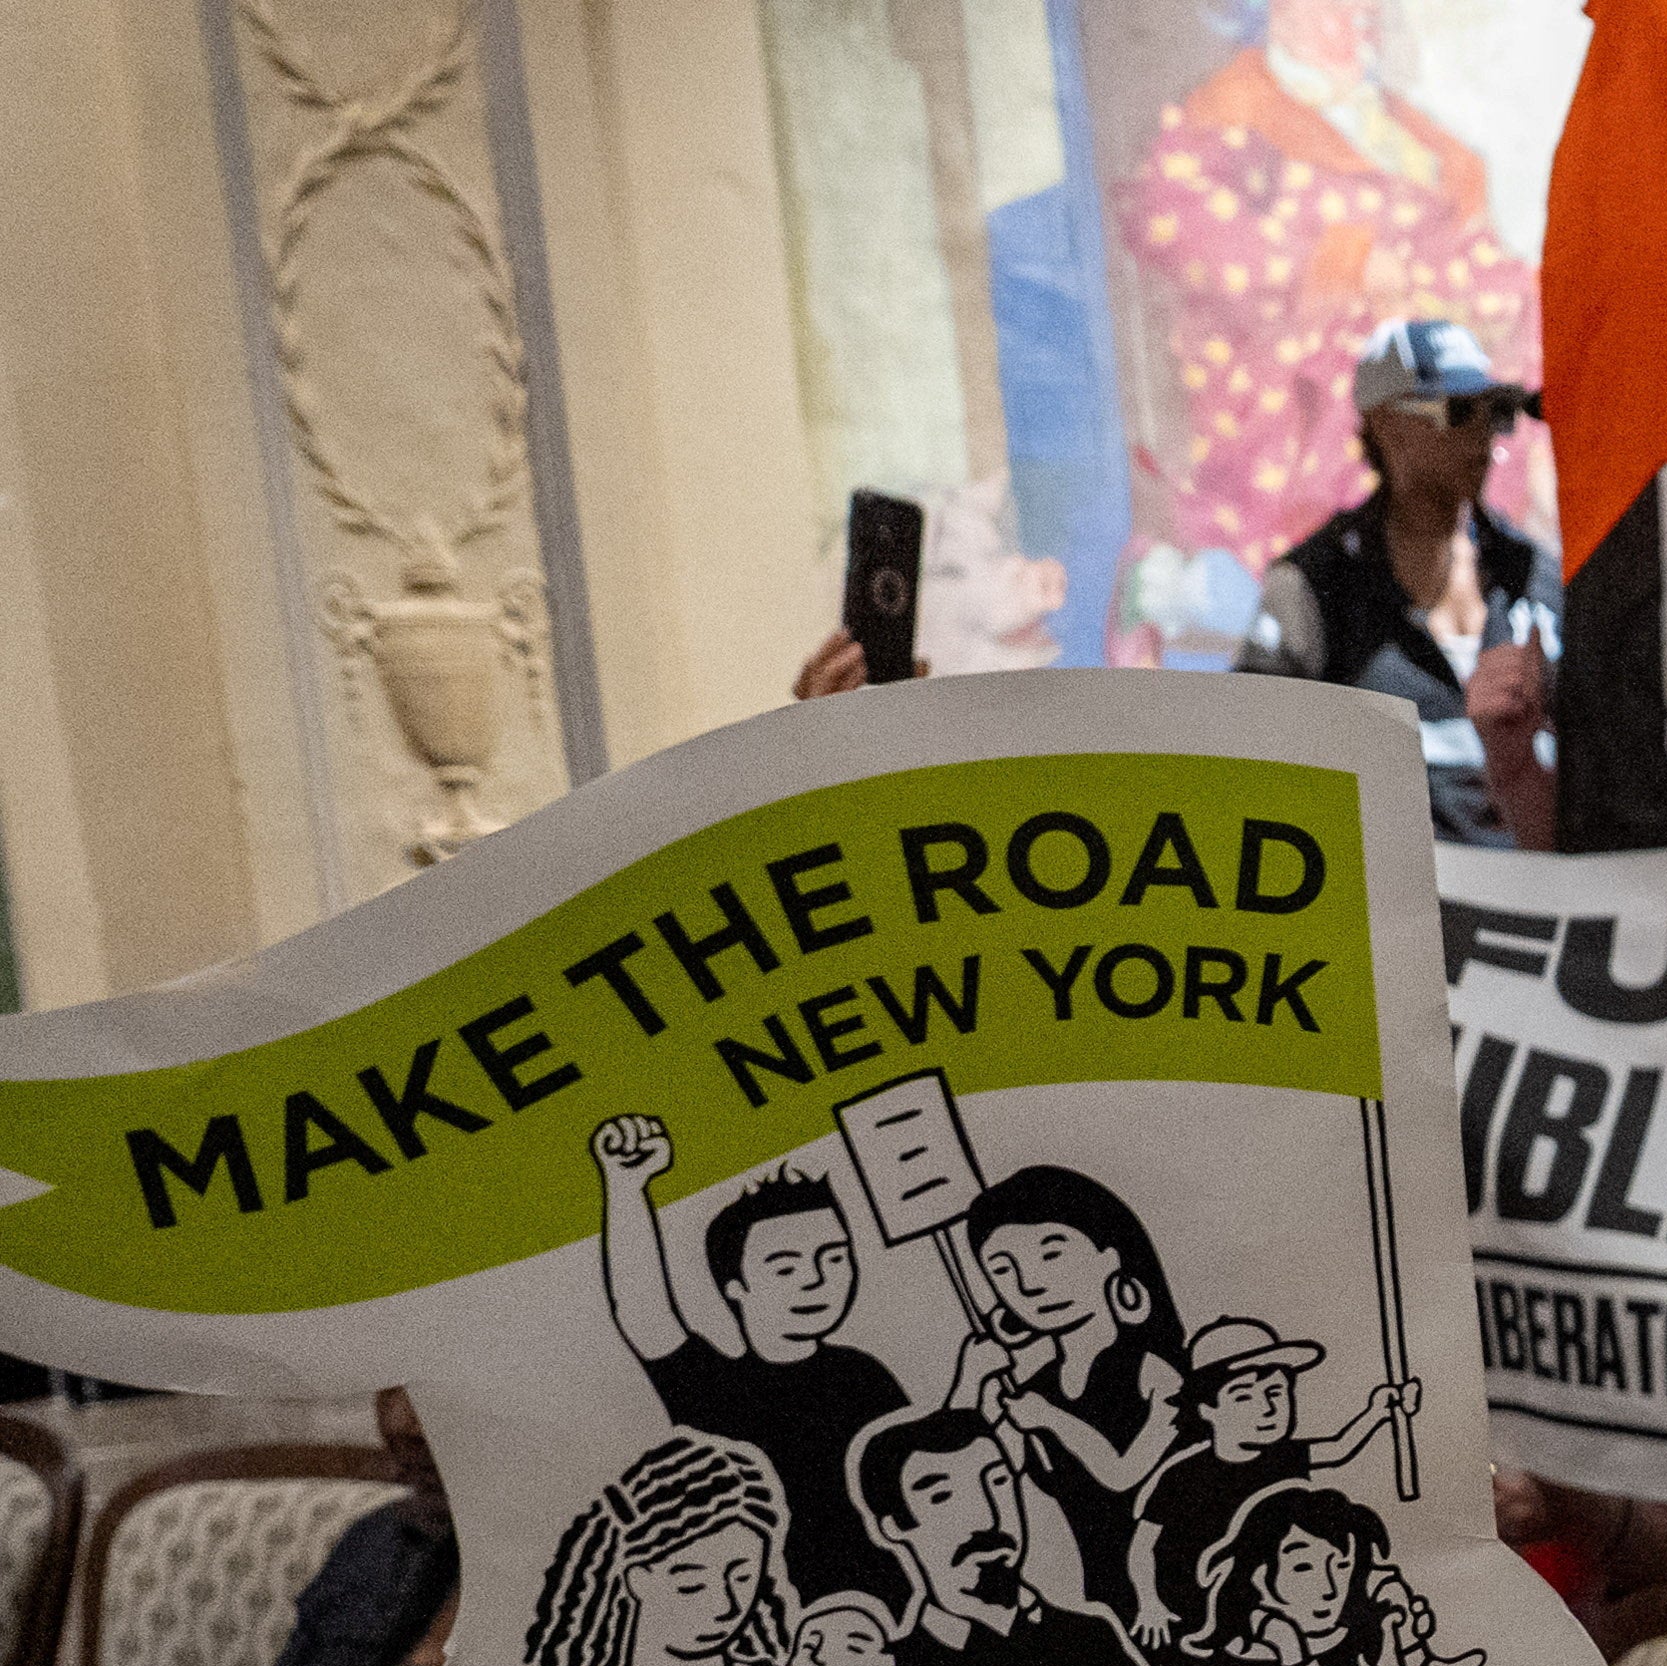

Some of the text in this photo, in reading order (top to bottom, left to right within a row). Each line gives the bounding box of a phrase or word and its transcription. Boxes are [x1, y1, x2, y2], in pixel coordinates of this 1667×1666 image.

[126, 811, 1328, 1230] MAKE THE ROAD
[713, 943, 1332, 1108] NEW YORK
